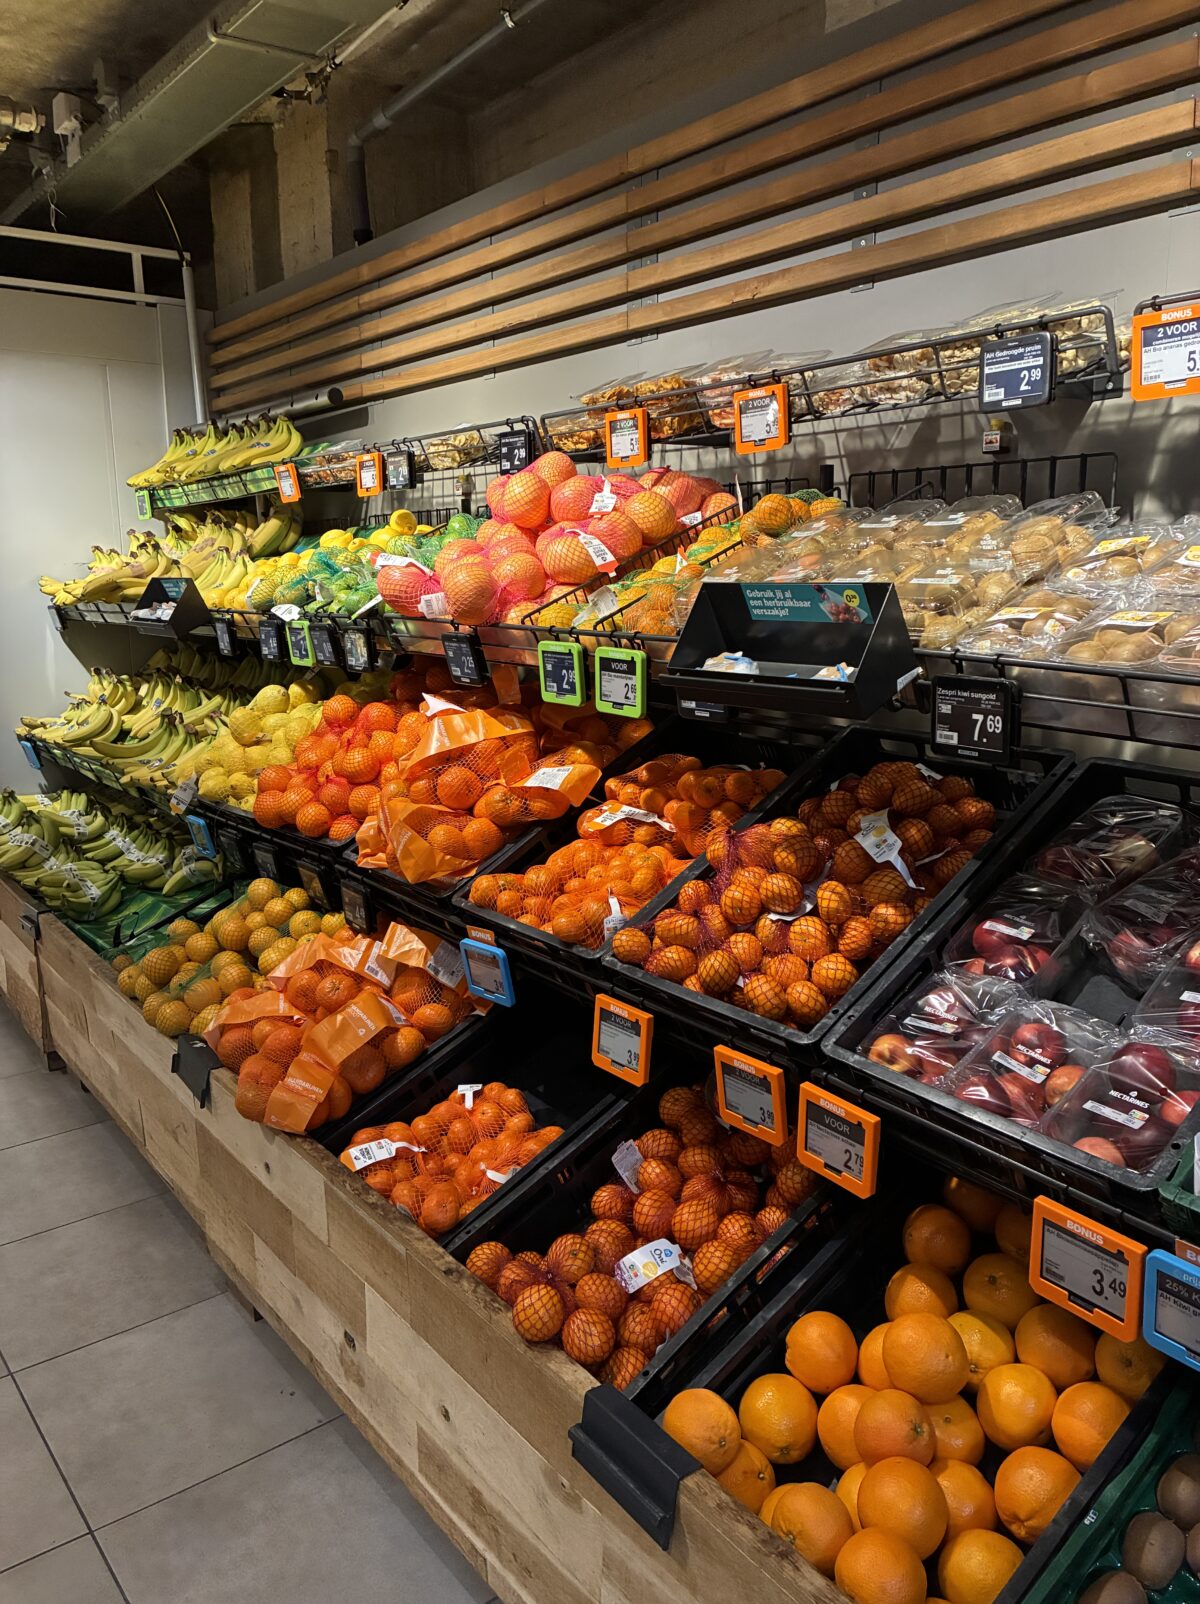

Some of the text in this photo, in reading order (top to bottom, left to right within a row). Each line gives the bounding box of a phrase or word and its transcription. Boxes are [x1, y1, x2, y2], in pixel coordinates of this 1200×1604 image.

[1161, 308, 1193, 322] BONUS
[1157, 321, 1198, 337] 2 VOOR
[995, 347, 1025, 358] Gedroogde
[1025, 344, 1041, 353] pruim
[1143, 346, 1152, 354] AH
[1019, 368, 1042, 391] 2.99
[753, 397, 771, 407] VOOR
[746, 589, 775, 598] Gebruik
[785, 590, 792, 598] al
[763, 599, 812, 608] herbruikbaar
[752, 608, 789, 617] verszakje?
[611, 661, 628, 671] VOOR
[937, 687, 957, 696] Zespri
[957, 689, 970, 697] kiwi
[970, 692, 997, 700] sungold
[971, 713, 1003, 743] 7.69
[471, 929, 492, 941] BONUS
[610, 1003, 629, 1018] BONUS
[923, 1005, 959, 1022] NECTARINES
[616, 1015, 632, 1029] VOOR
[1015, 1043, 1053, 1064] NECTARINES
[1108, 1089, 1150, 1109] NECTARINES
[820, 1098, 846, 1117] BONUS
[824, 1114, 850, 1135] VOOR
[1066, 1219, 1104, 1246] BONUS
[1186, 1248, 1200, 1264] B
[1091, 1268, 1128, 1300] 3.49
[1165, 1279, 1189, 1297] 25%
[1159, 1293, 1171, 1302] AH
[1173, 1298, 1191, 1312] Kiwi
